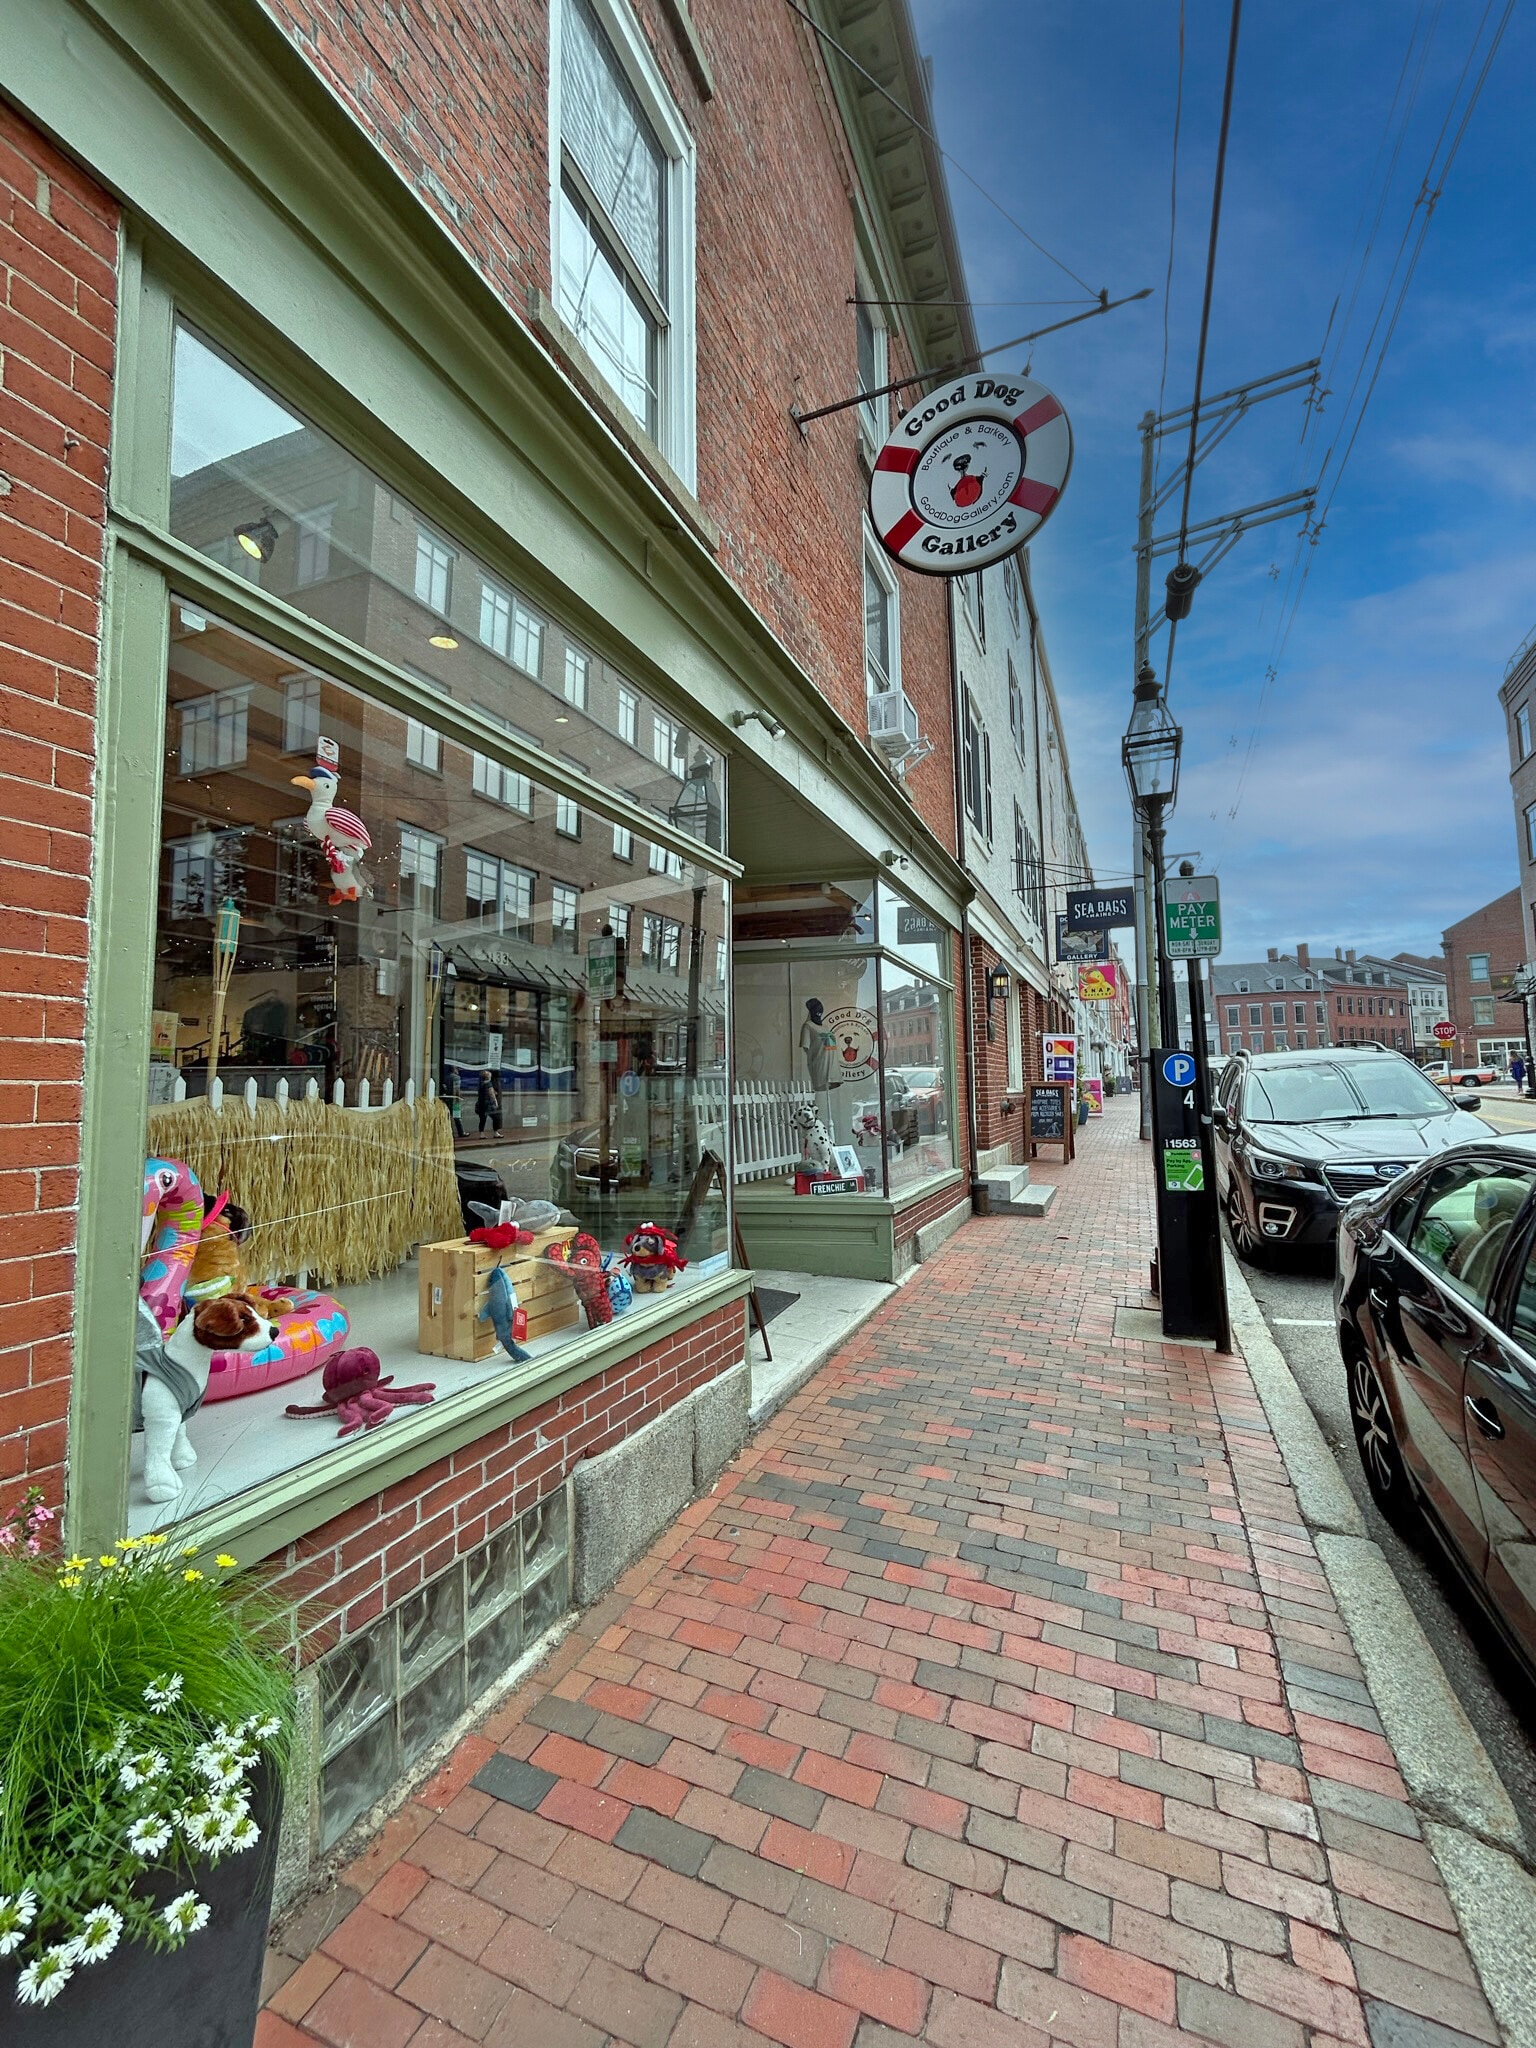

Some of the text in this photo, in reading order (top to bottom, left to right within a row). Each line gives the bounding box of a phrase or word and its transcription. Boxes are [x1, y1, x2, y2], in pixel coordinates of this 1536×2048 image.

[904, 379, 1025, 437] Good Dog
[921, 424, 1012, 471] Boutique & Barkery
[920, 471, 1014, 524] GoodDogGallery.com
[921, 511, 1018, 556] Gallery
[1074, 899, 1127, 920] SEA BAGS
[1178, 903, 1206, 916] PAY
[1170, 915, 1215, 928] METER
[829, 1011, 851, 1024] Good
[1434, 1026, 1455, 1035] STOP
[1174, 1059, 1190, 1081] P
[1036, 1089, 1059, 1097] SEA BAGS
[1184, 1090, 1194, 1109] 4
[813, 1182, 846, 1194] FRENCHIE
